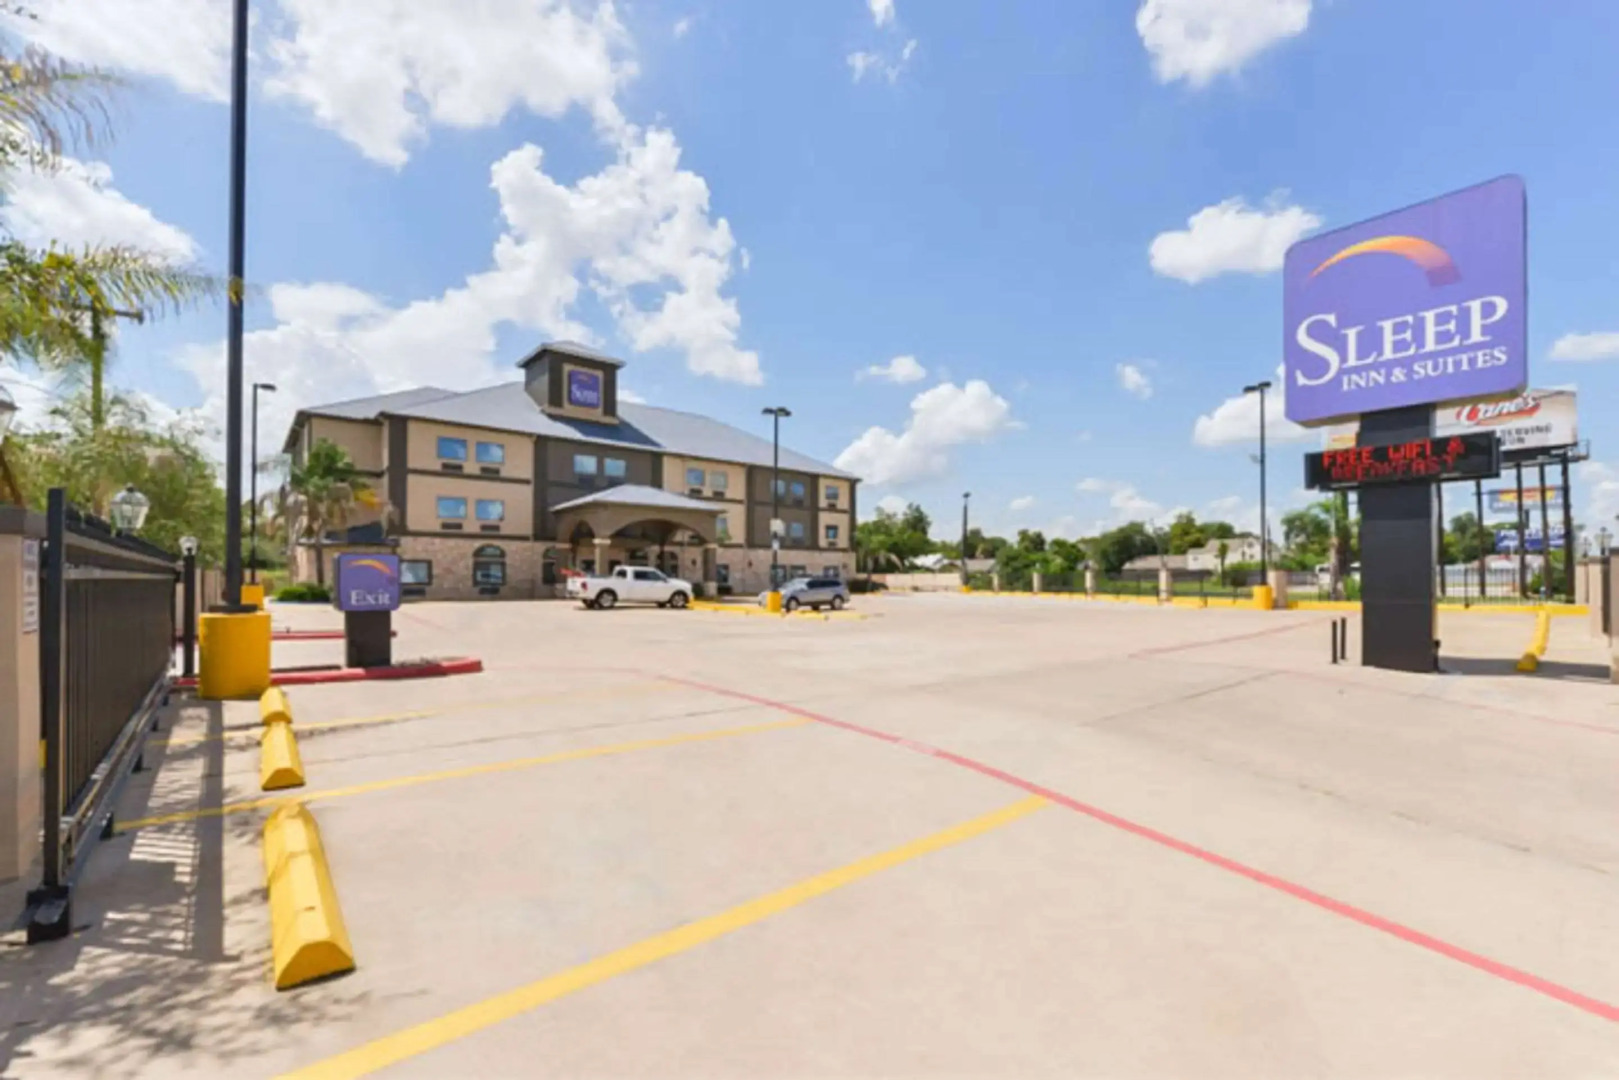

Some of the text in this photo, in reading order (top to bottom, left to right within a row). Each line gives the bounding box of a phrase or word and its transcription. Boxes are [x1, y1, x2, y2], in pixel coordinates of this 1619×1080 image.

[1295, 295, 1508, 386] SLEEP
[1342, 346, 1508, 391] INN & SUITES
[1322, 446, 1375, 471] FREE
[1388, 438, 1433, 462] WIFI
